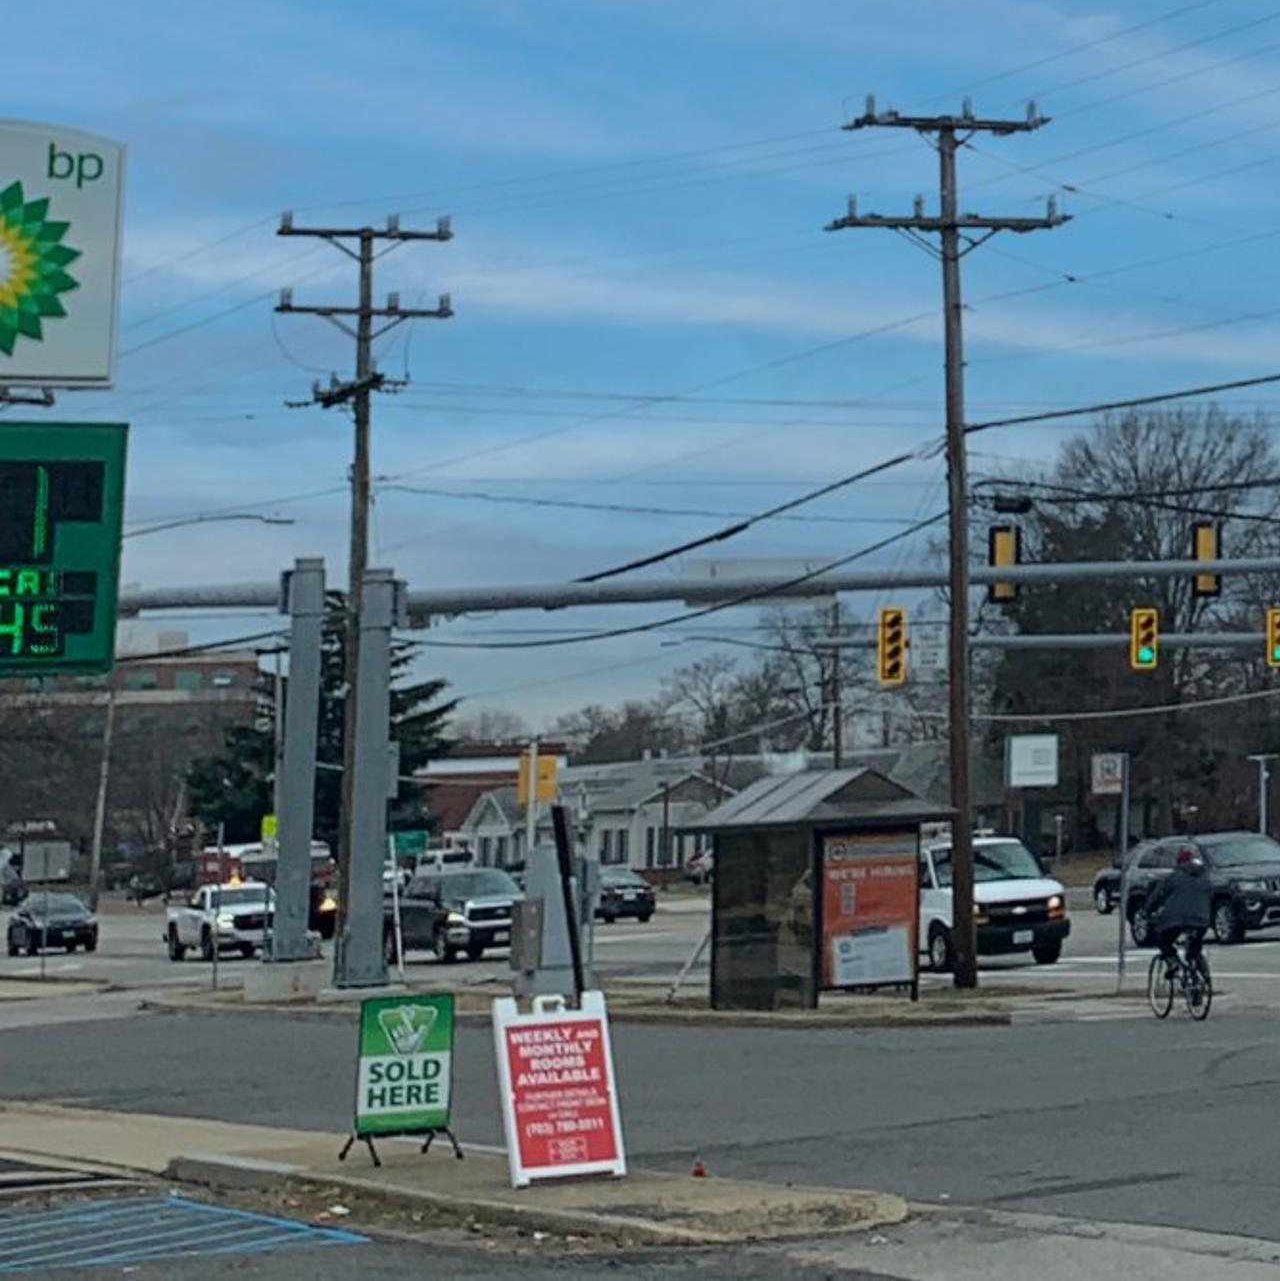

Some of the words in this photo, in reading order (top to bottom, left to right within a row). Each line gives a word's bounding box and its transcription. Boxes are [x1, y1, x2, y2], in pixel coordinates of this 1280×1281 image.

[48, 141, 104, 190] bp
[510, 1028, 572, 1044] WEEKLY
[518, 1040, 593, 1059] MONTHLY
[368, 1058, 442, 1085] SOLD
[530, 1055, 586, 1071] ROOMS
[517, 1067, 601, 1087] AVAILABLE
[367, 1082, 440, 1109] HERE
